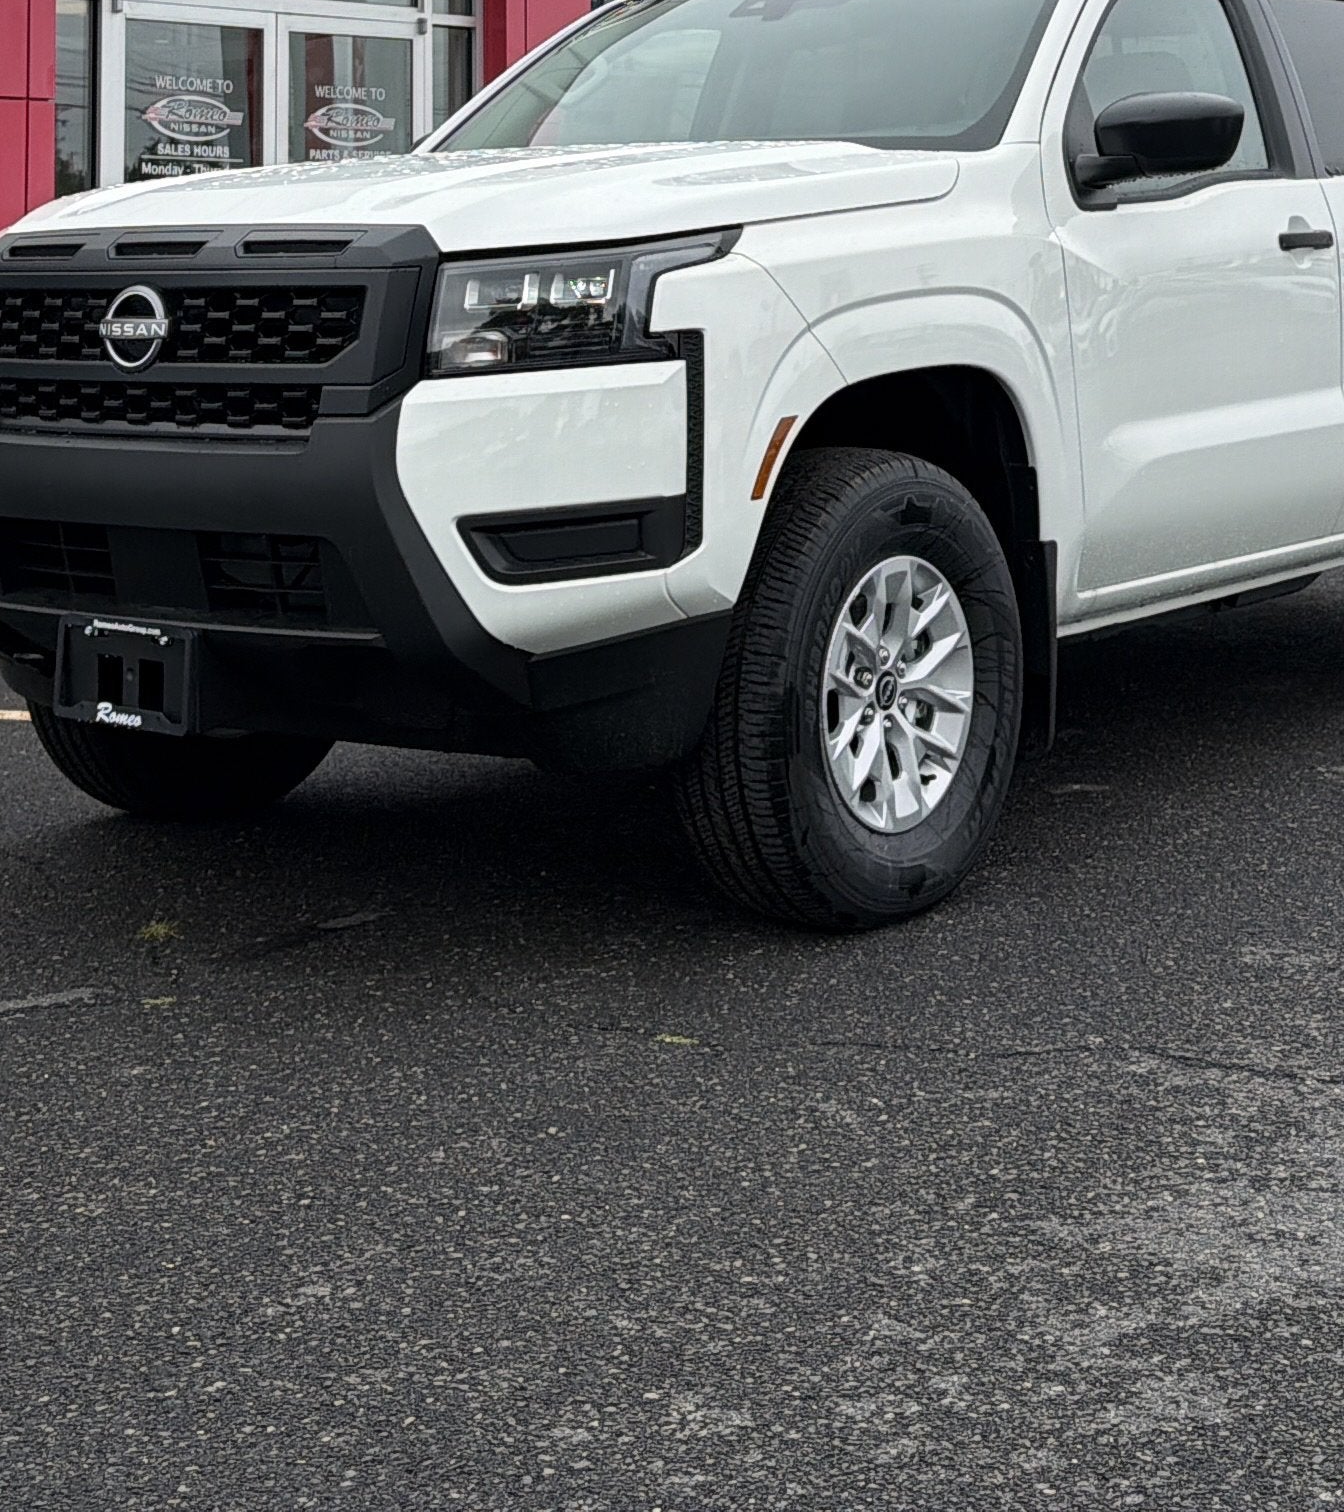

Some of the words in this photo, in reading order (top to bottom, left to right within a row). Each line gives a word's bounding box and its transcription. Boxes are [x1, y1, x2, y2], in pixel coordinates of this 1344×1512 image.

[155, 75, 213, 93] WELCOME
[218, 79, 234, 94] TO
[314, 85, 367, 100] WELCOME
[370, 88, 386, 101] TO
[161, 99, 228, 121] Romeo
[321, 107, 381, 128] Romeo
[169, 122, 216, 134] NISSAN
[329, 129, 371, 139] NISSAN
[157, 143, 191, 156] SALES
[193, 145, 230, 158] HOURS
[309, 149, 340, 162] PARTS
[141, 161, 185, 176] Monday
[99, 323, 166, 336] NISSAN
[96, 701, 143, 727] Romeo
